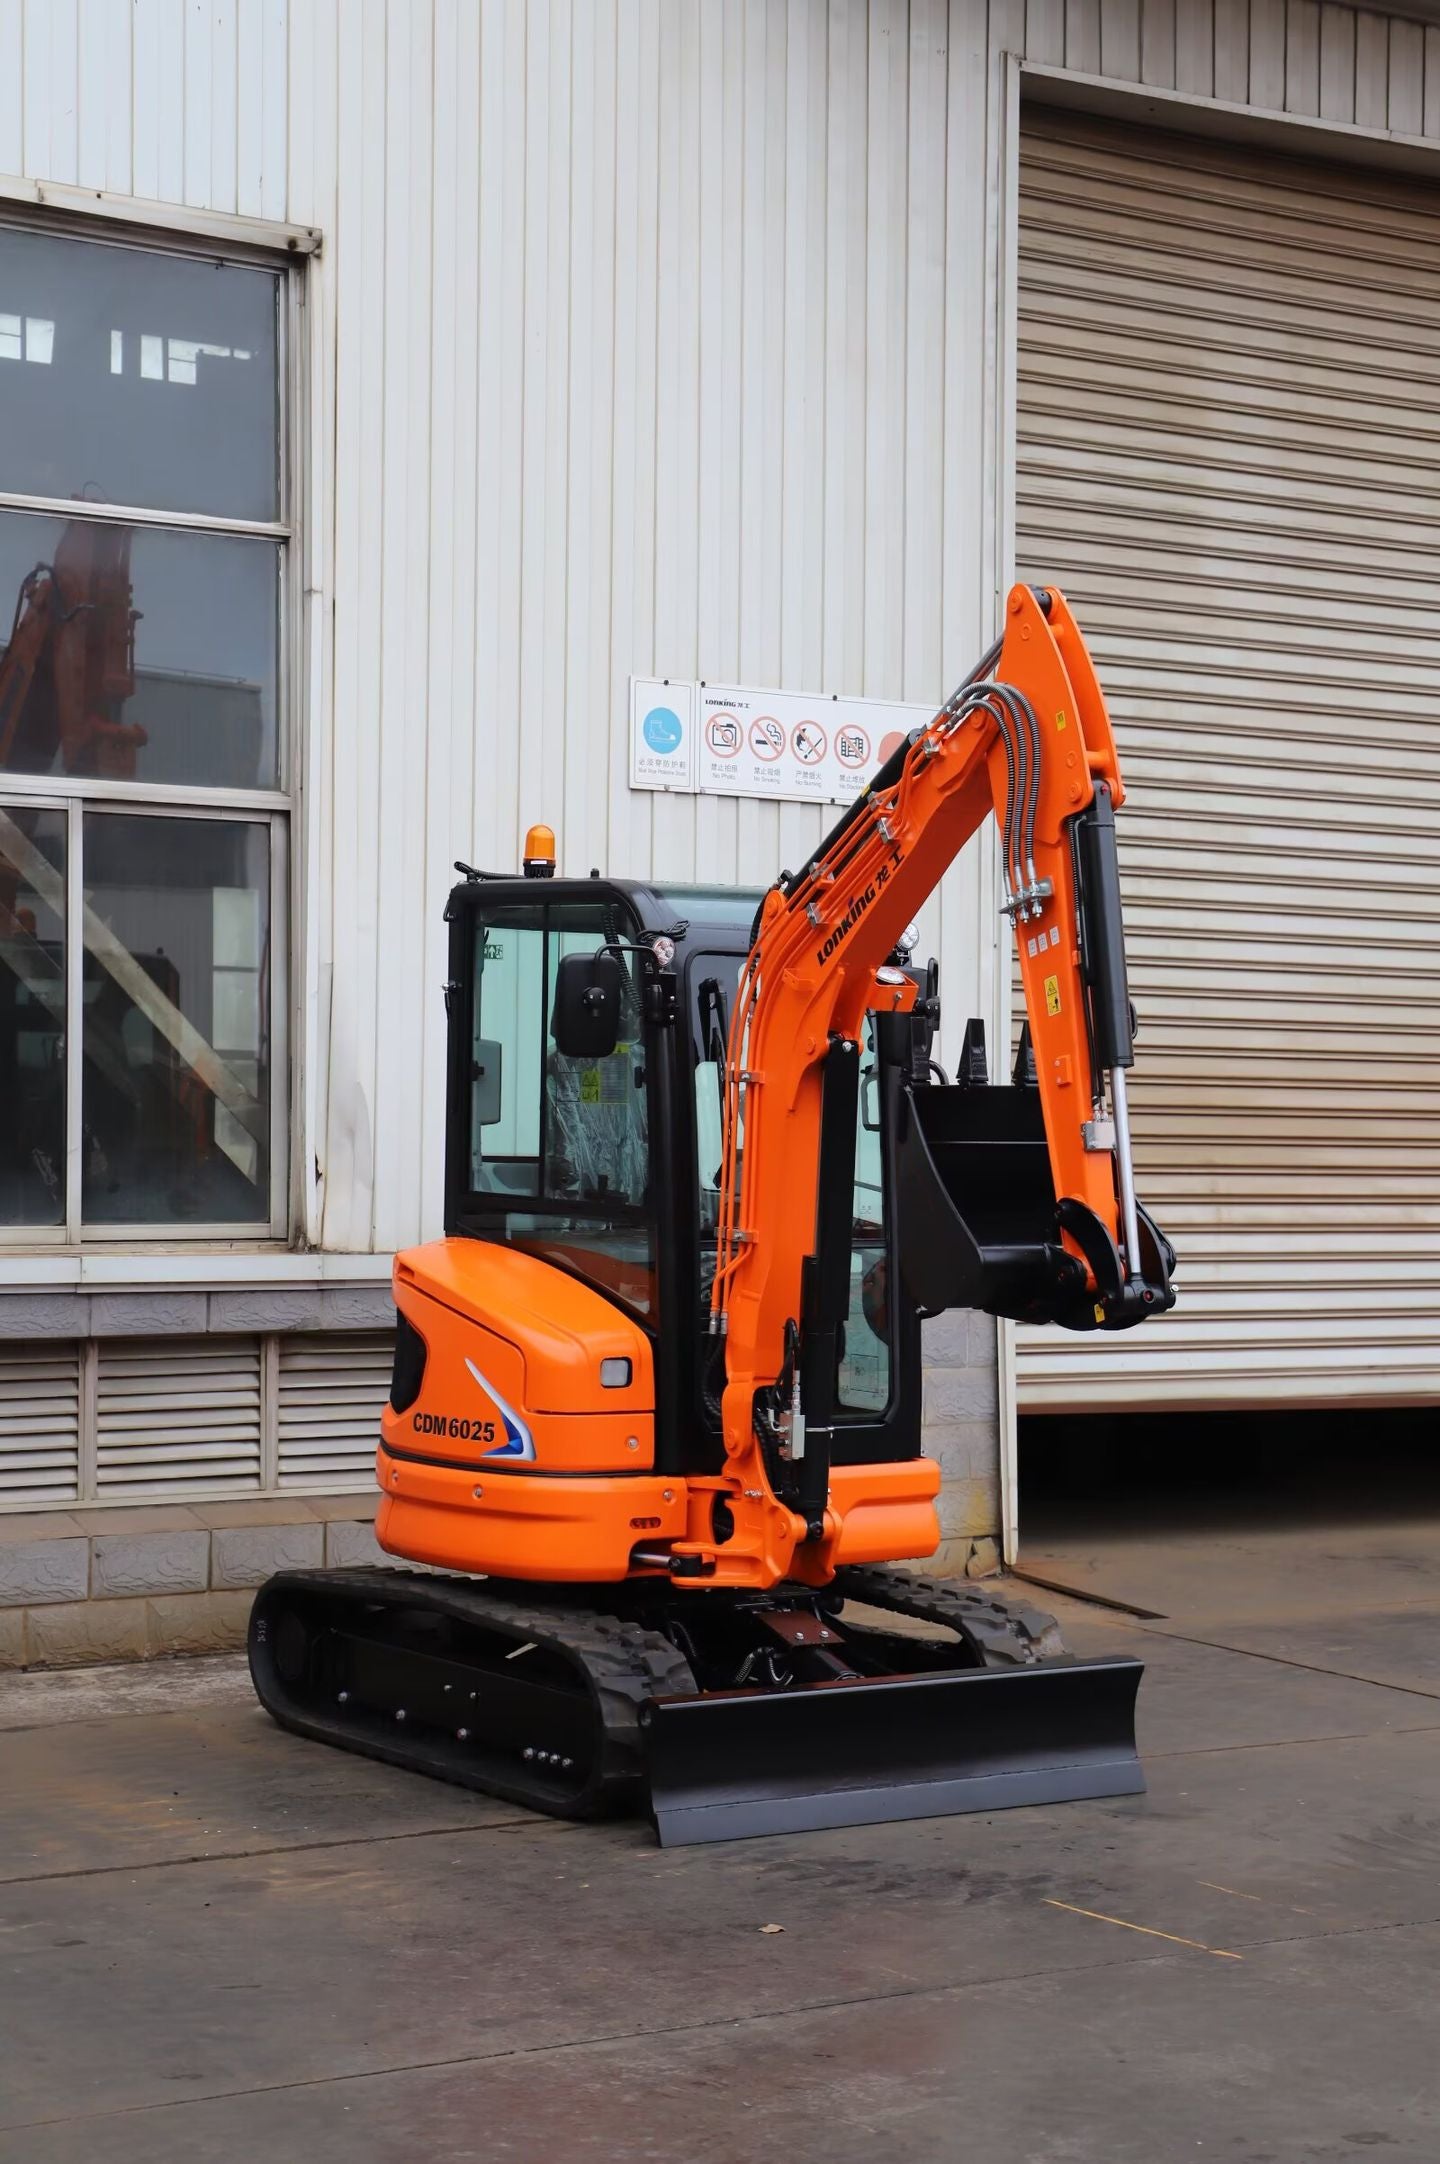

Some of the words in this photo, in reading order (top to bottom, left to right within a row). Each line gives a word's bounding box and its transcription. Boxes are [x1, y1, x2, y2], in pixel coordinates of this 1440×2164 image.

[754, 767, 781, 777] 禁止吸烟
[413, 1412, 495, 1442] CDM6025
